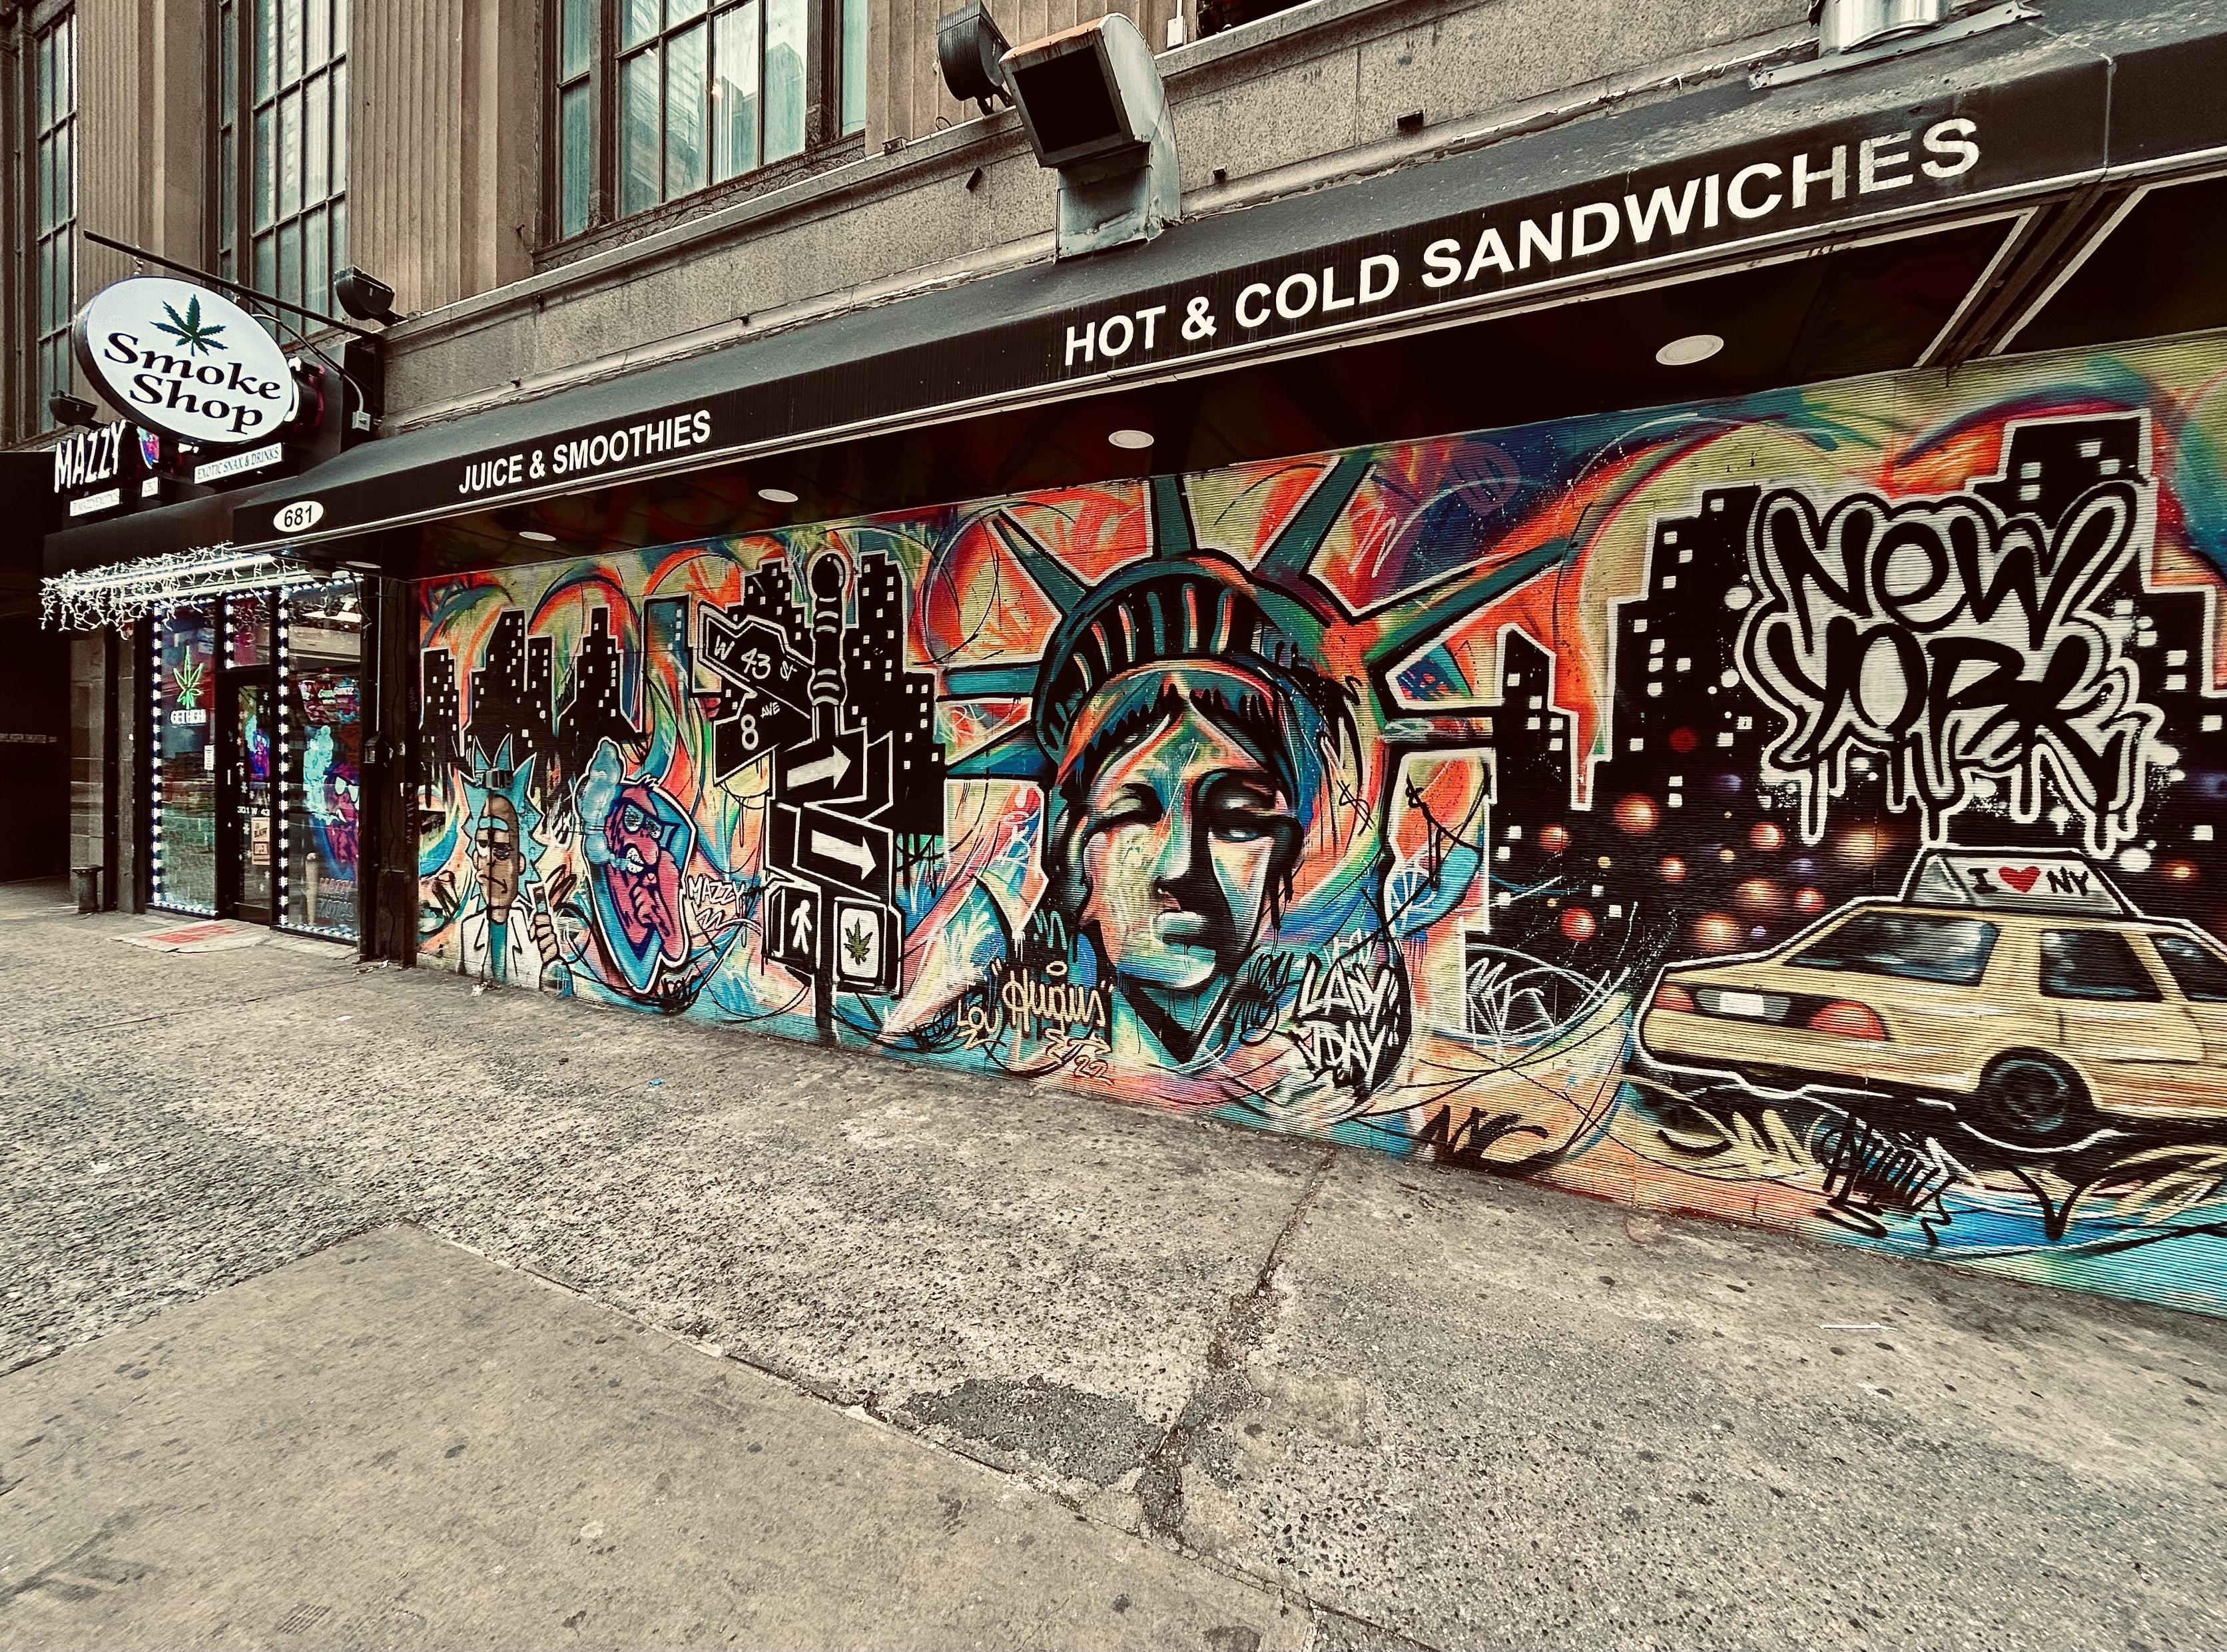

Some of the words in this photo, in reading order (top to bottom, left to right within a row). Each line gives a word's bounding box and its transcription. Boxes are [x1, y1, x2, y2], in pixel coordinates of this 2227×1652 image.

[1066, 305, 1166, 366] HOT
[1181, 296, 1217, 340] &
[1235, 254, 1399, 328] COLD
[1421, 118, 1981, 288] SANDWICHES
[104, 332, 281, 400] Smoke
[129, 374, 263, 435] Shop
[54, 419, 127, 493] MAZZY
[223, 457, 243, 472] SNAX
[251, 447, 280, 464] DRINKS
[459, 454, 523, 493] JUICE
[529, 450, 545, 479] &
[553, 410, 711, 474] SMOOTHIES
[284, 505, 312, 527] 681
[714, 635, 735, 661] W
[741, 647, 771, 680] 43
[741, 714, 759, 750] 8
[761, 702, 781, 718] AVE
[689, 876, 745, 914] MAZZY
[1967, 868, 1998, 894] I
[2046, 866, 2089, 897] NY
